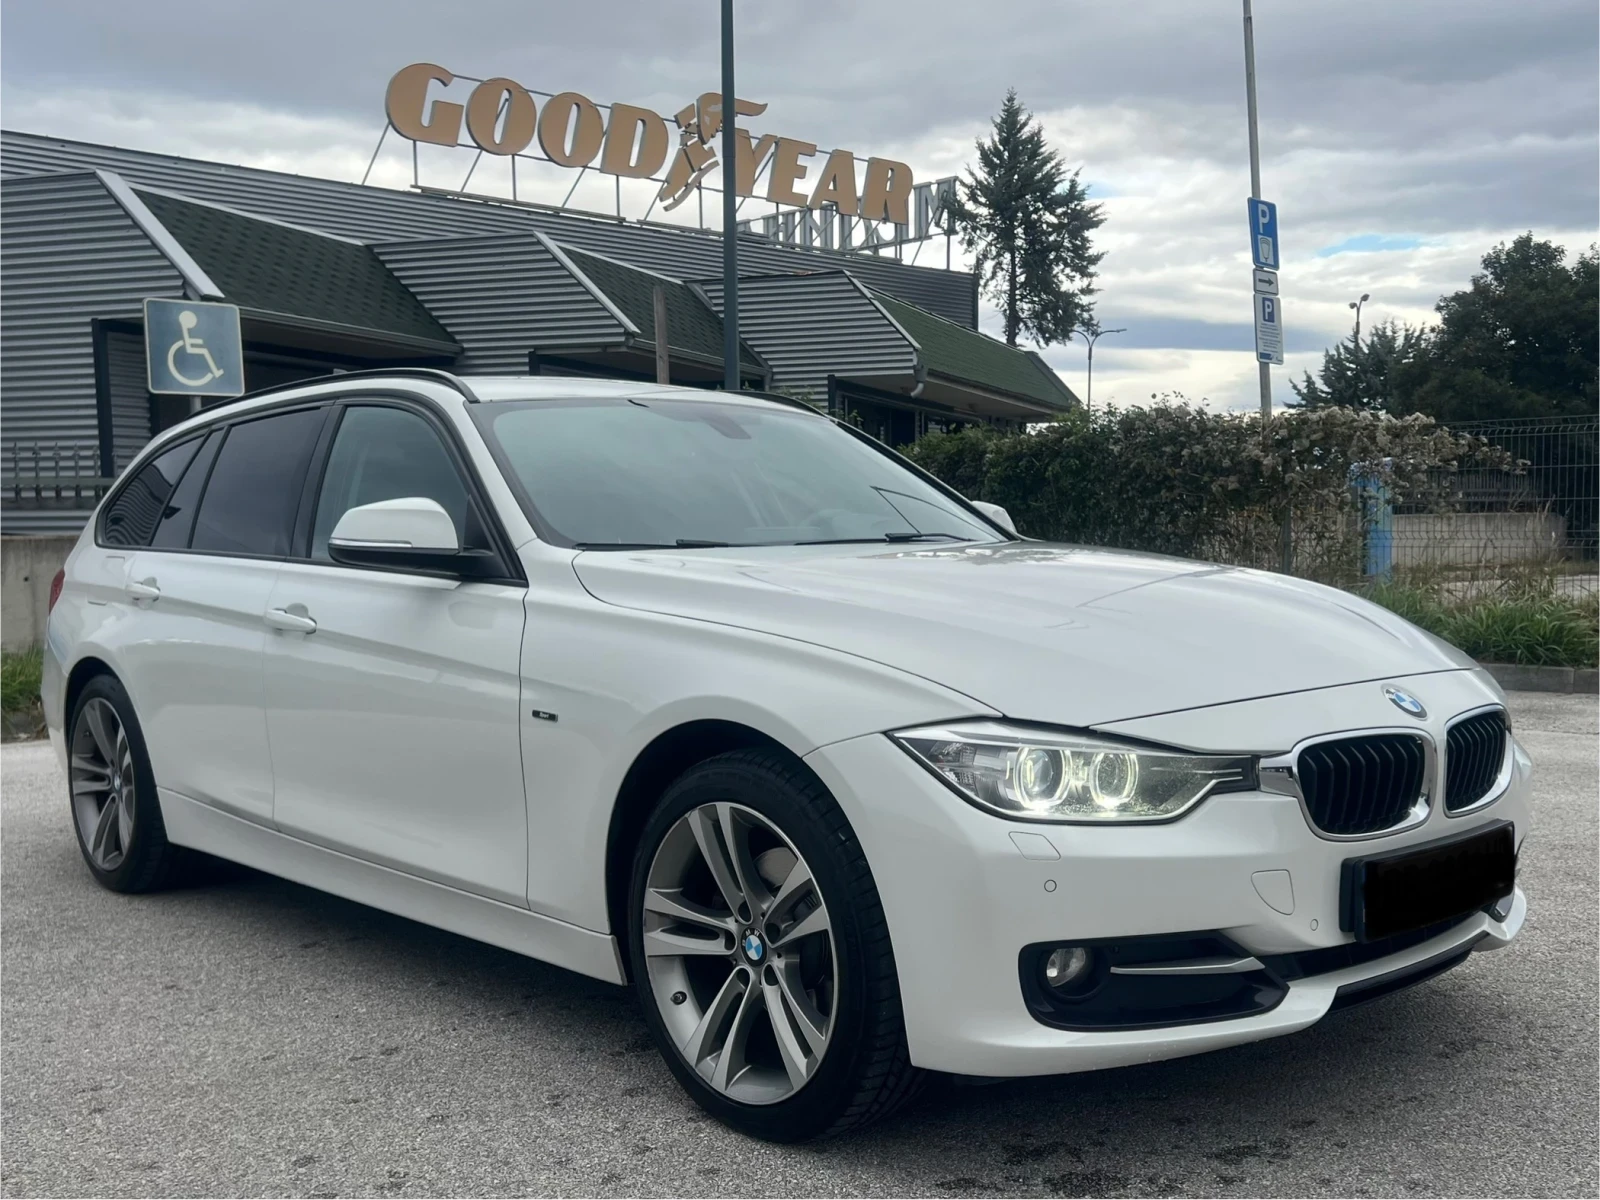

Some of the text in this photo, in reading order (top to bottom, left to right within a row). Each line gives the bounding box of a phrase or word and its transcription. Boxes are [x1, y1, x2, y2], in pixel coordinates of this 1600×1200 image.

[385, 62, 669, 178] GOOD
[734, 127, 913, 225] YEAR
[1257, 203, 1270, 234] P
[1264, 300, 1273, 320] P
